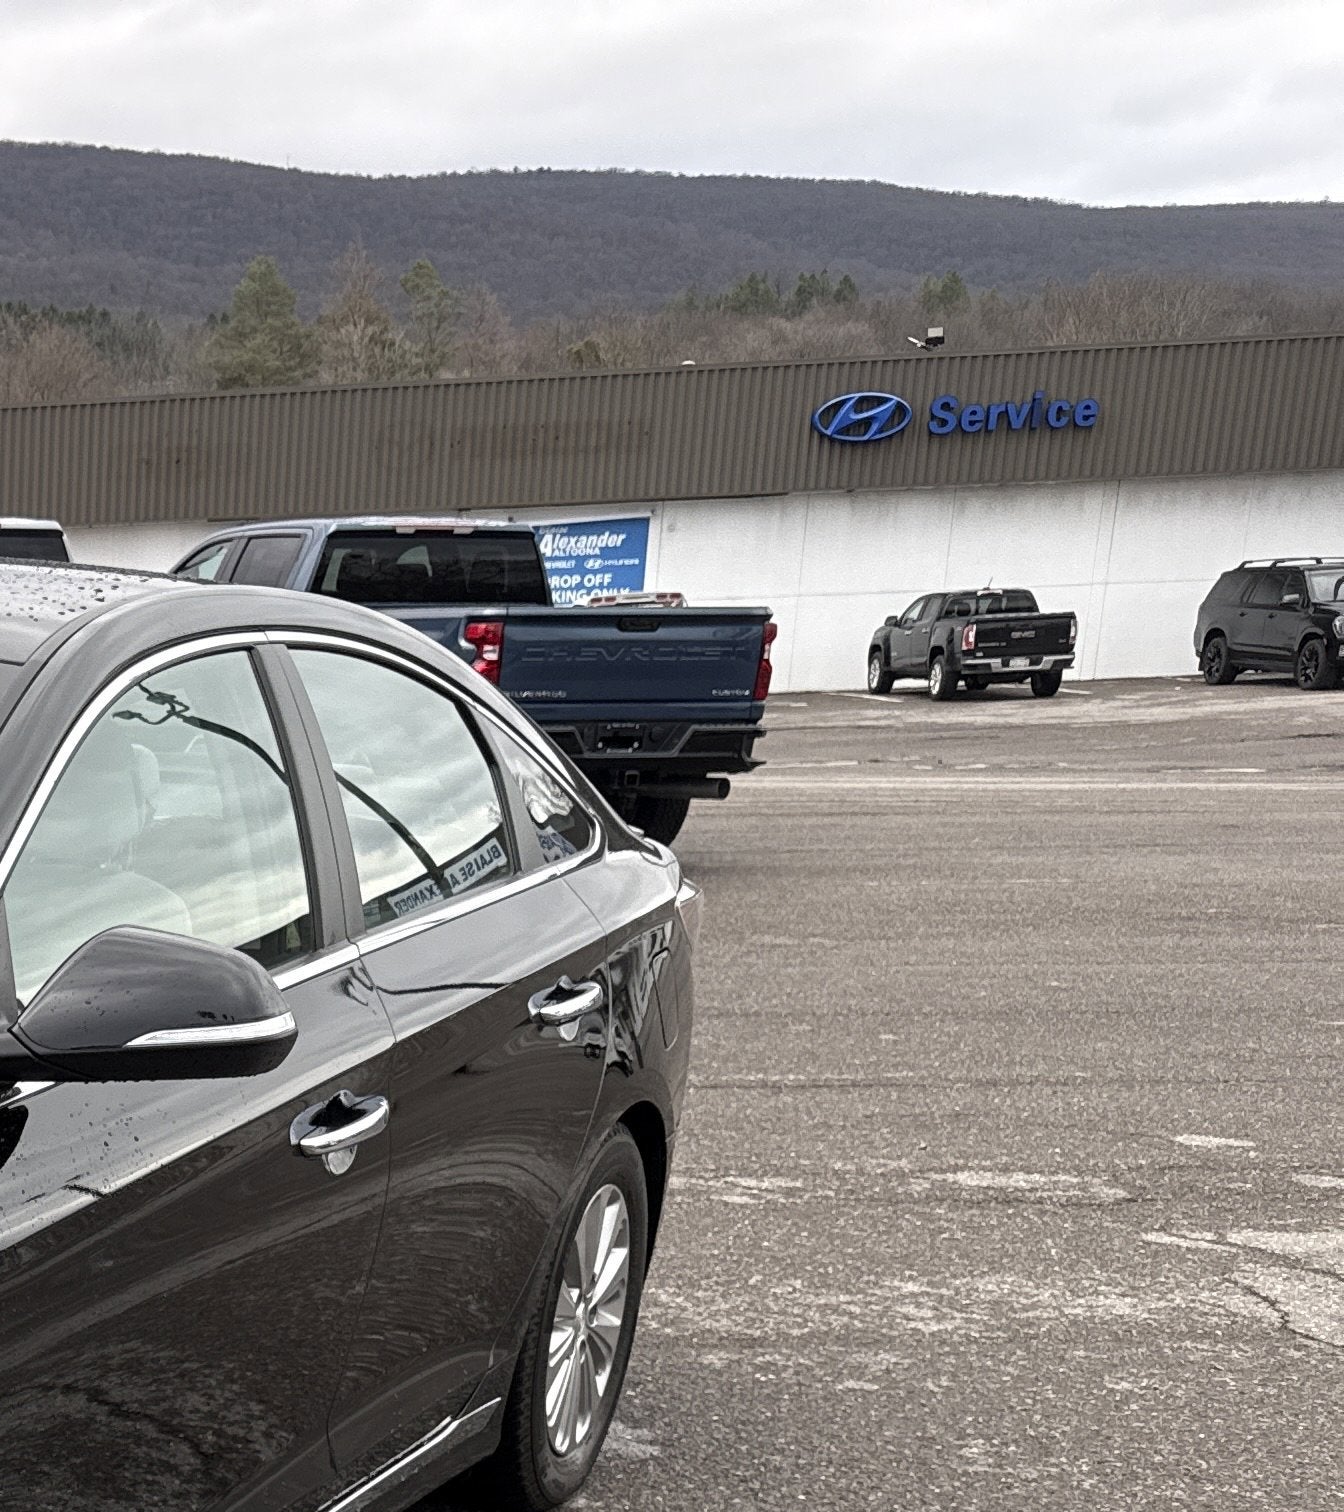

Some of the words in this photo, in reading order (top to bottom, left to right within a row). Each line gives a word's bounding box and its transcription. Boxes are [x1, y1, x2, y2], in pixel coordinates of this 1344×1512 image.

[928, 390, 1099, 435] Service
[539, 531, 626, 557] Alexander
[548, 574, 581, 589] ROP
[583, 573, 612, 587] OFF
[552, 588, 587, 603] KING
